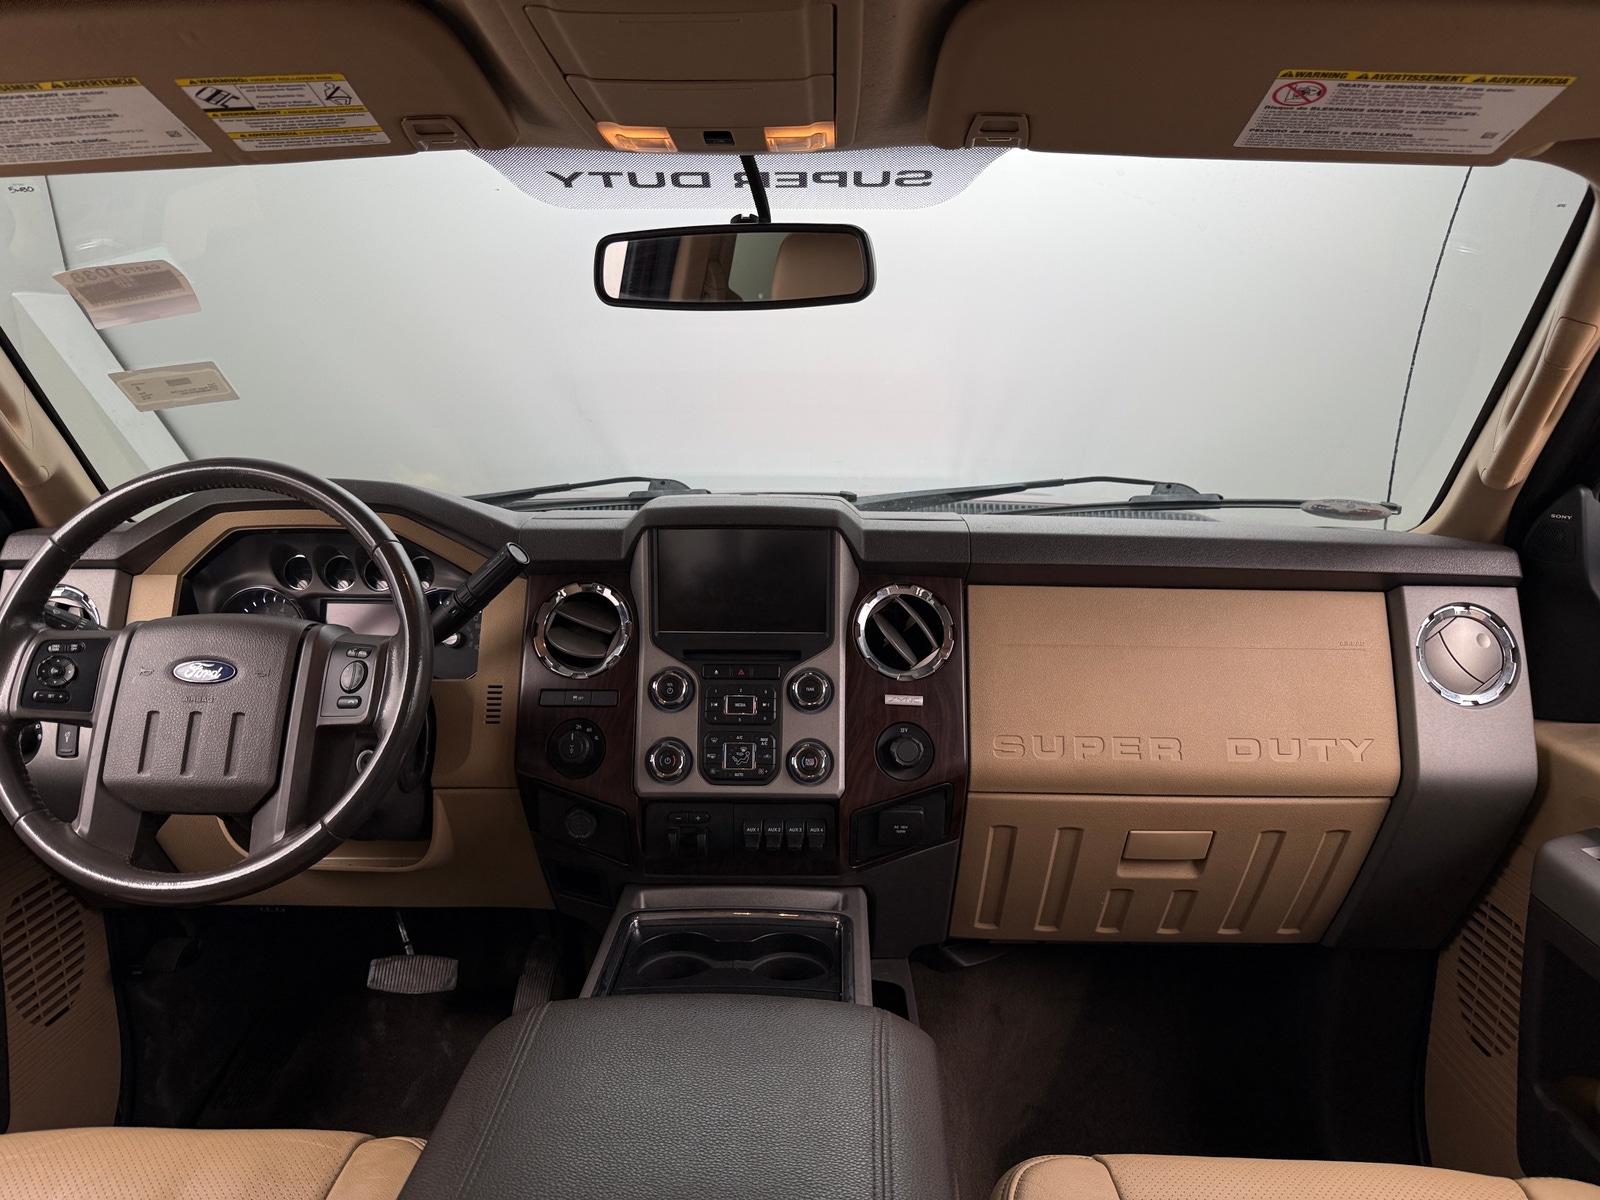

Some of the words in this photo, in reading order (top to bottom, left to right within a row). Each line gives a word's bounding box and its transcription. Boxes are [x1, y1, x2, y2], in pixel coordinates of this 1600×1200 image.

[1370, 73, 1468, 82] AVERTISSEMENT
[1488, 77, 1569, 85] ADVERTENCIA
[62, 78, 137, 88] ADVERTENCIA
[184, 663, 223, 679] Ford
[992, 734, 1184, 762] SUPER
[1227, 736, 1375, 763] DUTY
